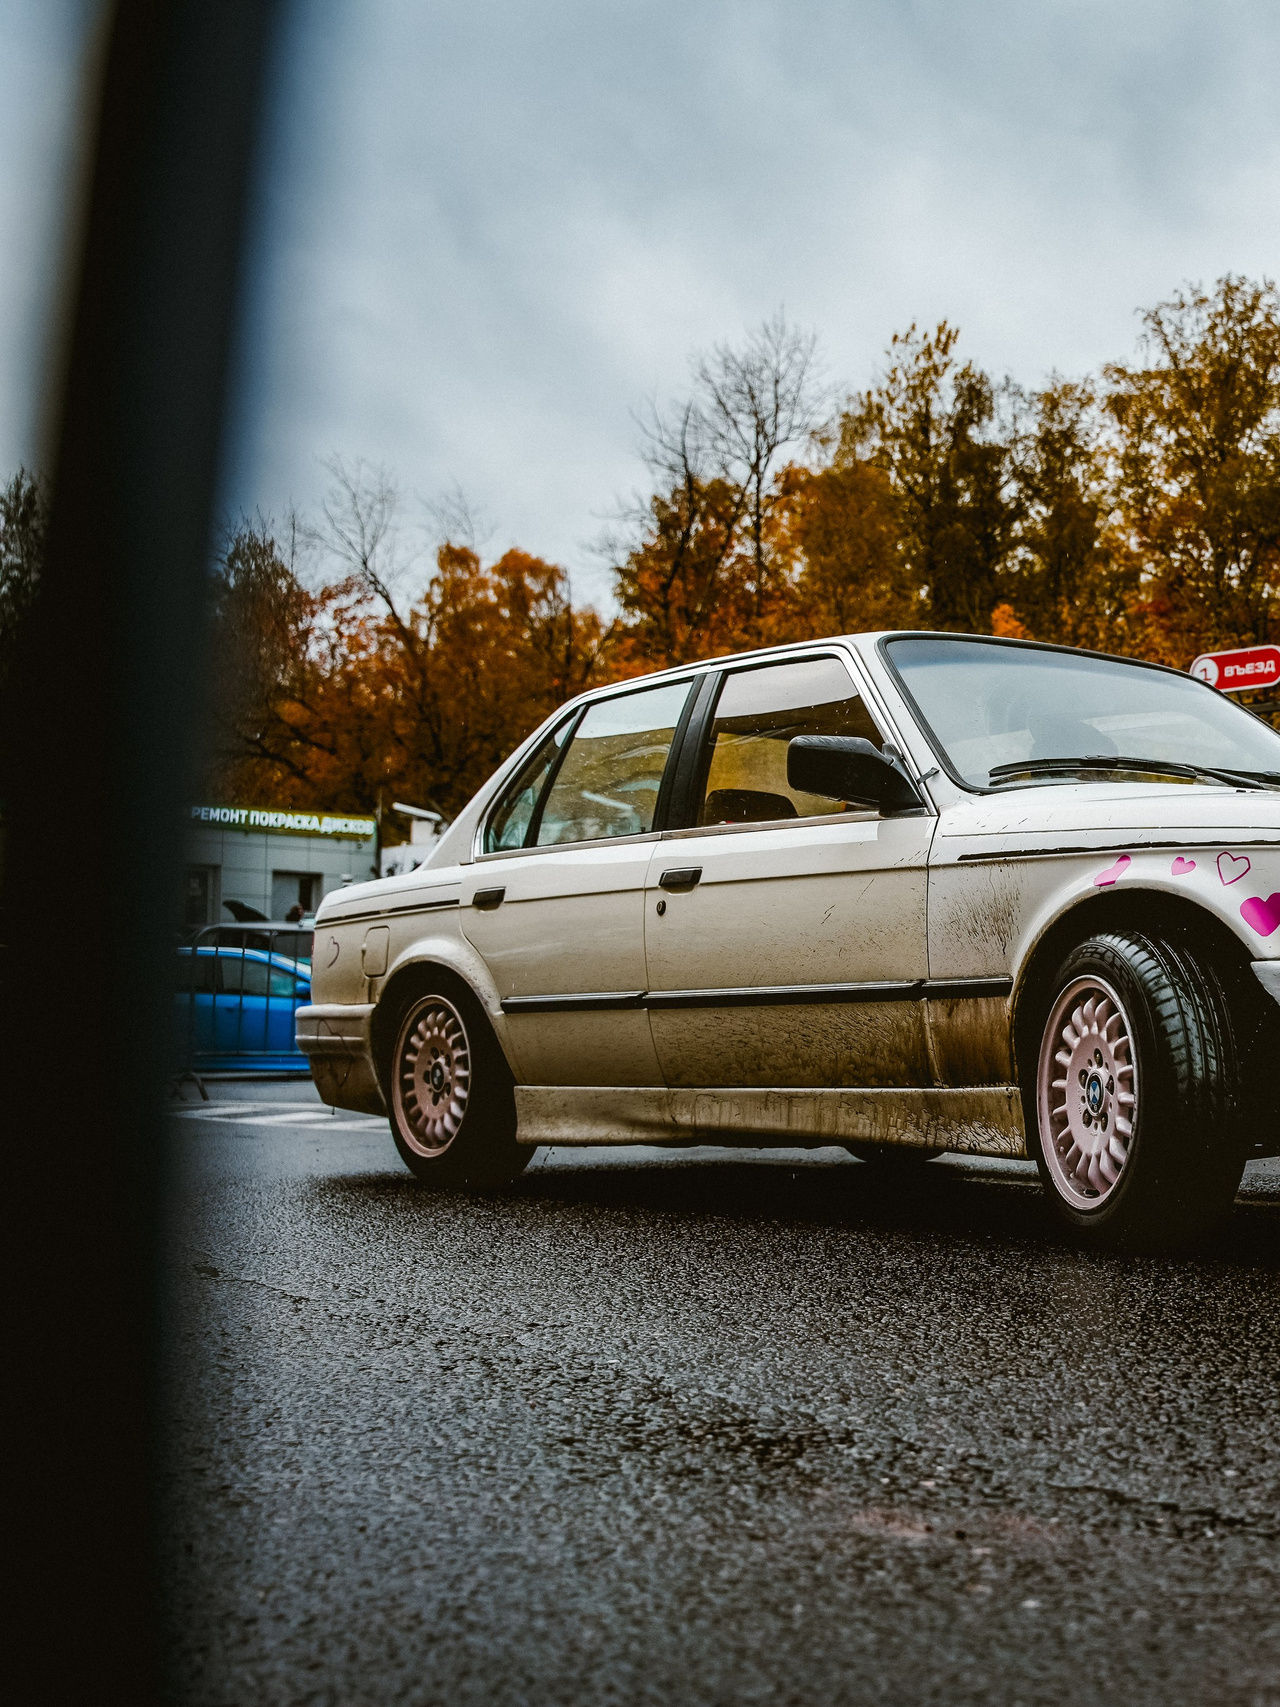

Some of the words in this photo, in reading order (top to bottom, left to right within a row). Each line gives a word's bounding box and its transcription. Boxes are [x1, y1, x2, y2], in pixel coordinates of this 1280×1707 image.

[1199, 667, 1212, 681] 1
[1223, 659, 1276, 678] ВЪЕЗД
[191, 806, 249, 824] РЕМОНТ
[250, 810, 320, 831] ПОКРАСКА
[320, 816, 375, 835] ДИСКОВ
